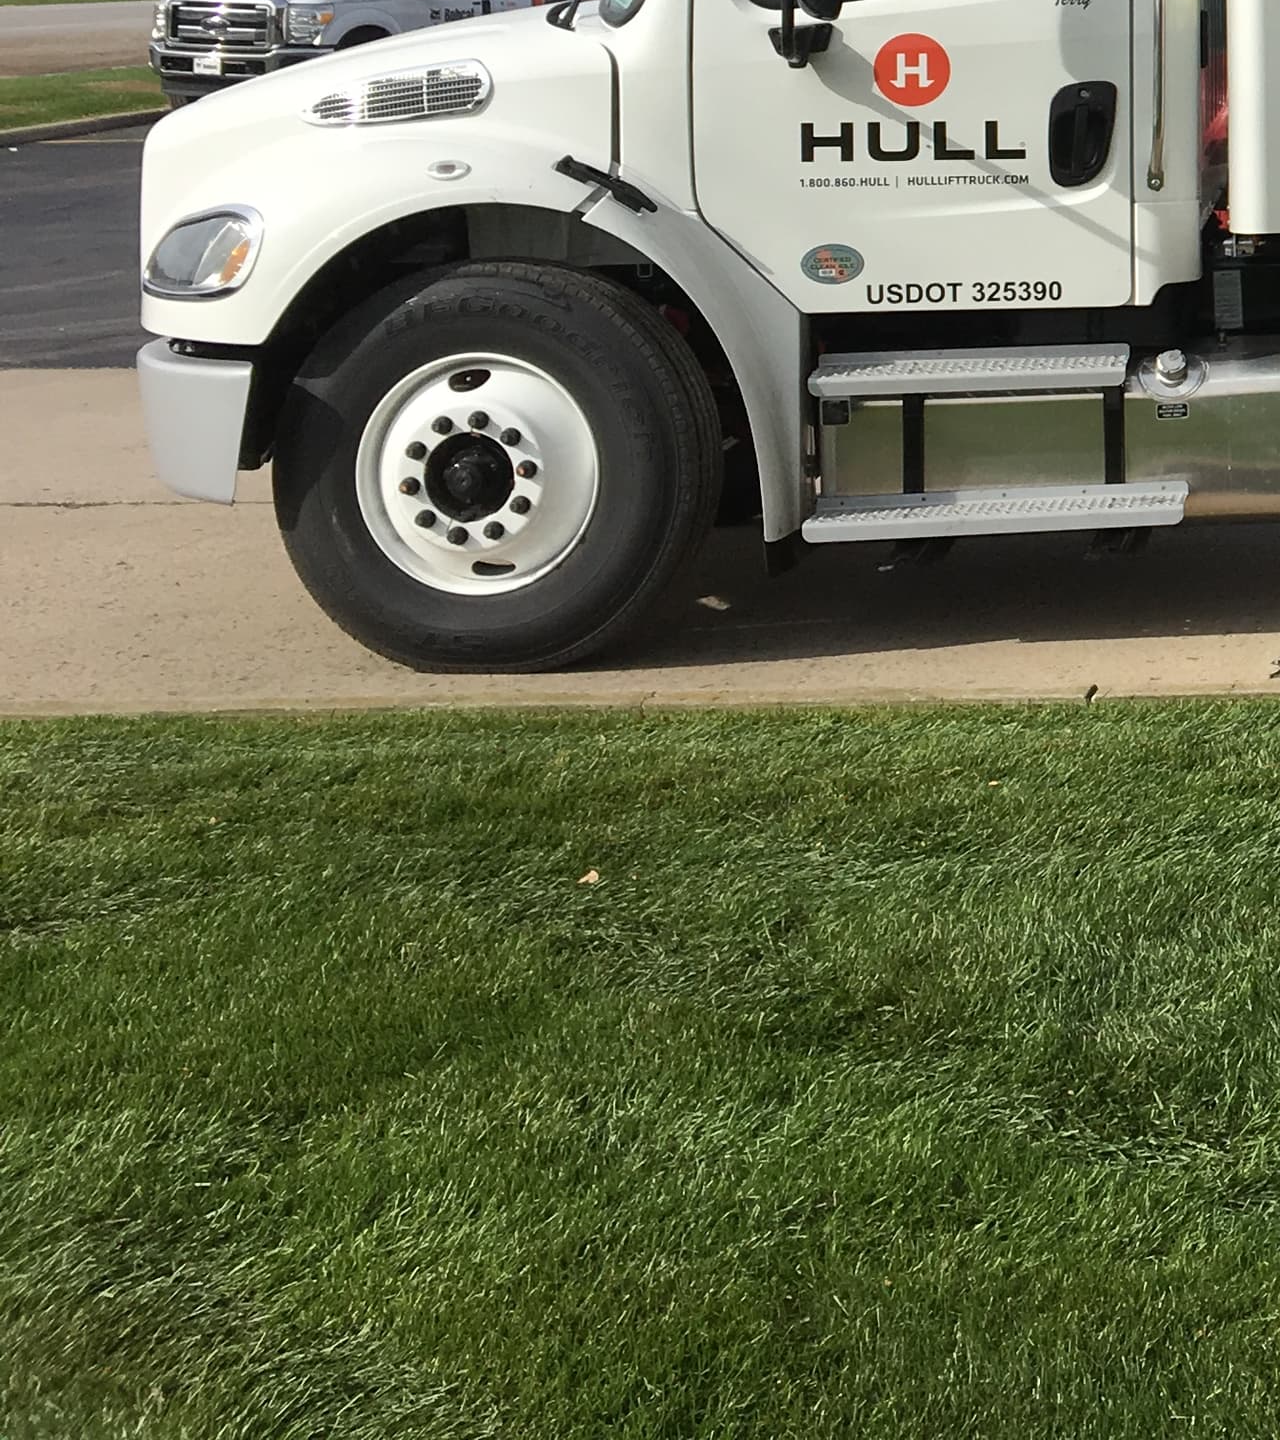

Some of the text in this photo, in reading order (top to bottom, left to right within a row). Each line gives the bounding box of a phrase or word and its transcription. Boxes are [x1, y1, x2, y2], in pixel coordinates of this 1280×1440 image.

[889, 53, 935, 88] H
[800, 120, 1026, 162] HULL
[800, 175, 1029, 188] 1.800.860.HULL HULLLIFTTRUCK.COM
[866, 281, 1062, 304] USDOT 325390
